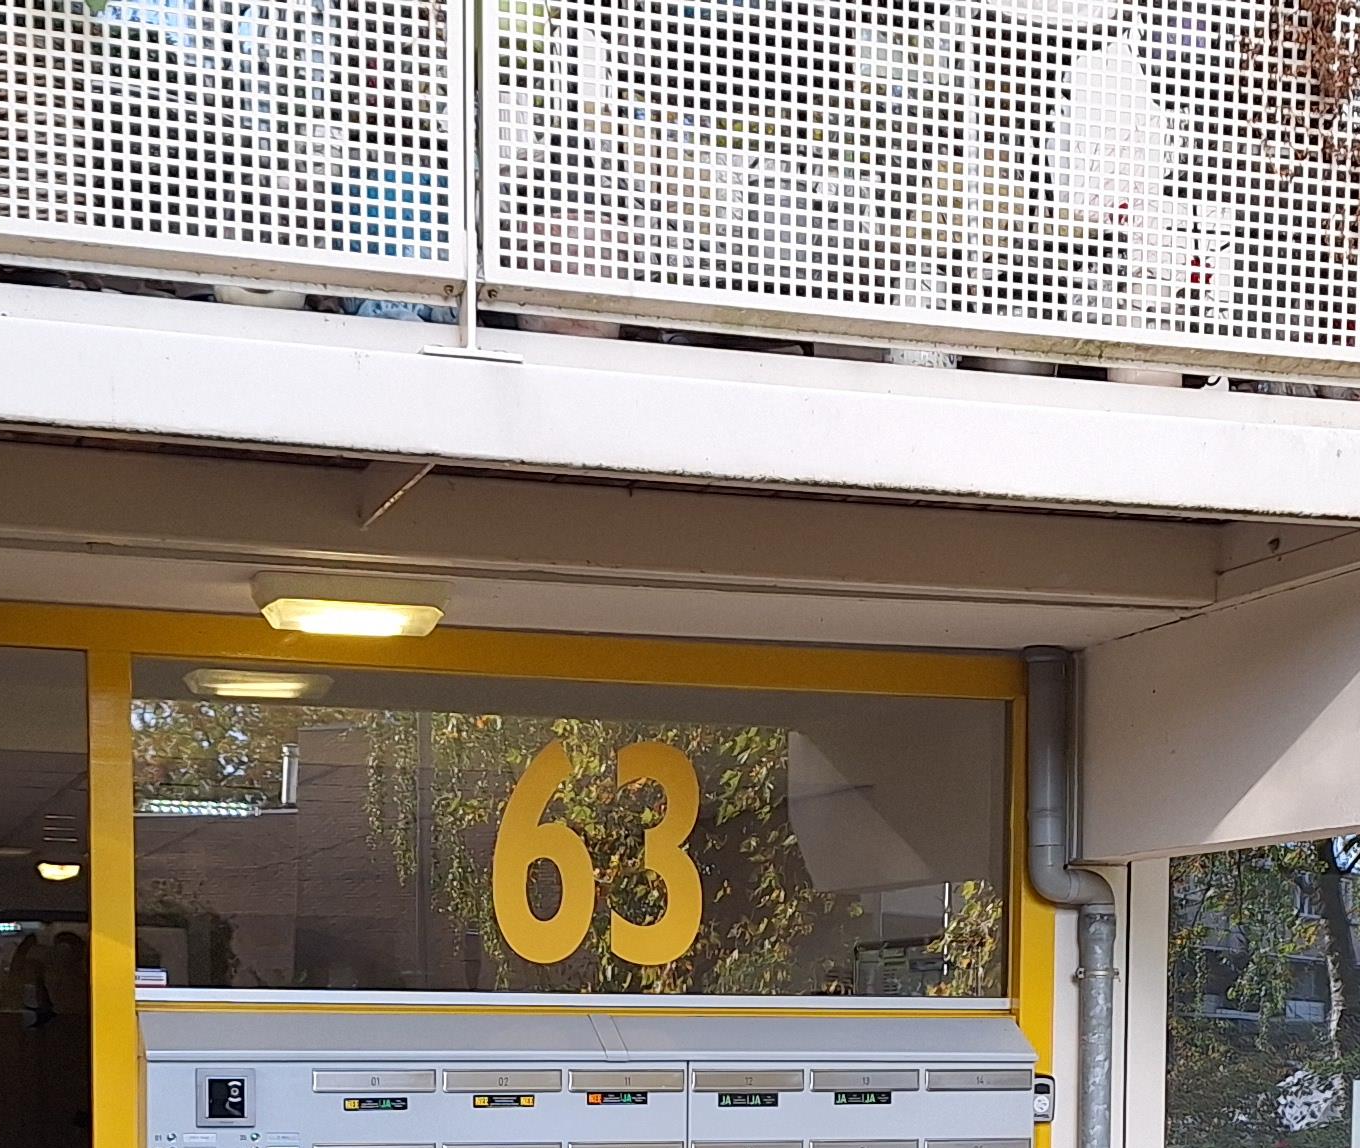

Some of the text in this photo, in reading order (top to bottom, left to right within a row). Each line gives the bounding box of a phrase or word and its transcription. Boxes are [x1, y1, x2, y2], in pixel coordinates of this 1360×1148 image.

[492, 739, 703, 966] 63
[371, 1077, 380, 1086] 01
[498, 1077, 509, 1086] 02
[625, 1077, 631, 1086] 11
[623, 1093, 632, 1103] JA
[720, 1096, 731, 1105] JA
[750, 1095, 761, 1104] JA
[835, 1094, 847, 1103] JA
[865, 1093, 876, 1102] JA
[382, 1099, 390, 1108] JA
